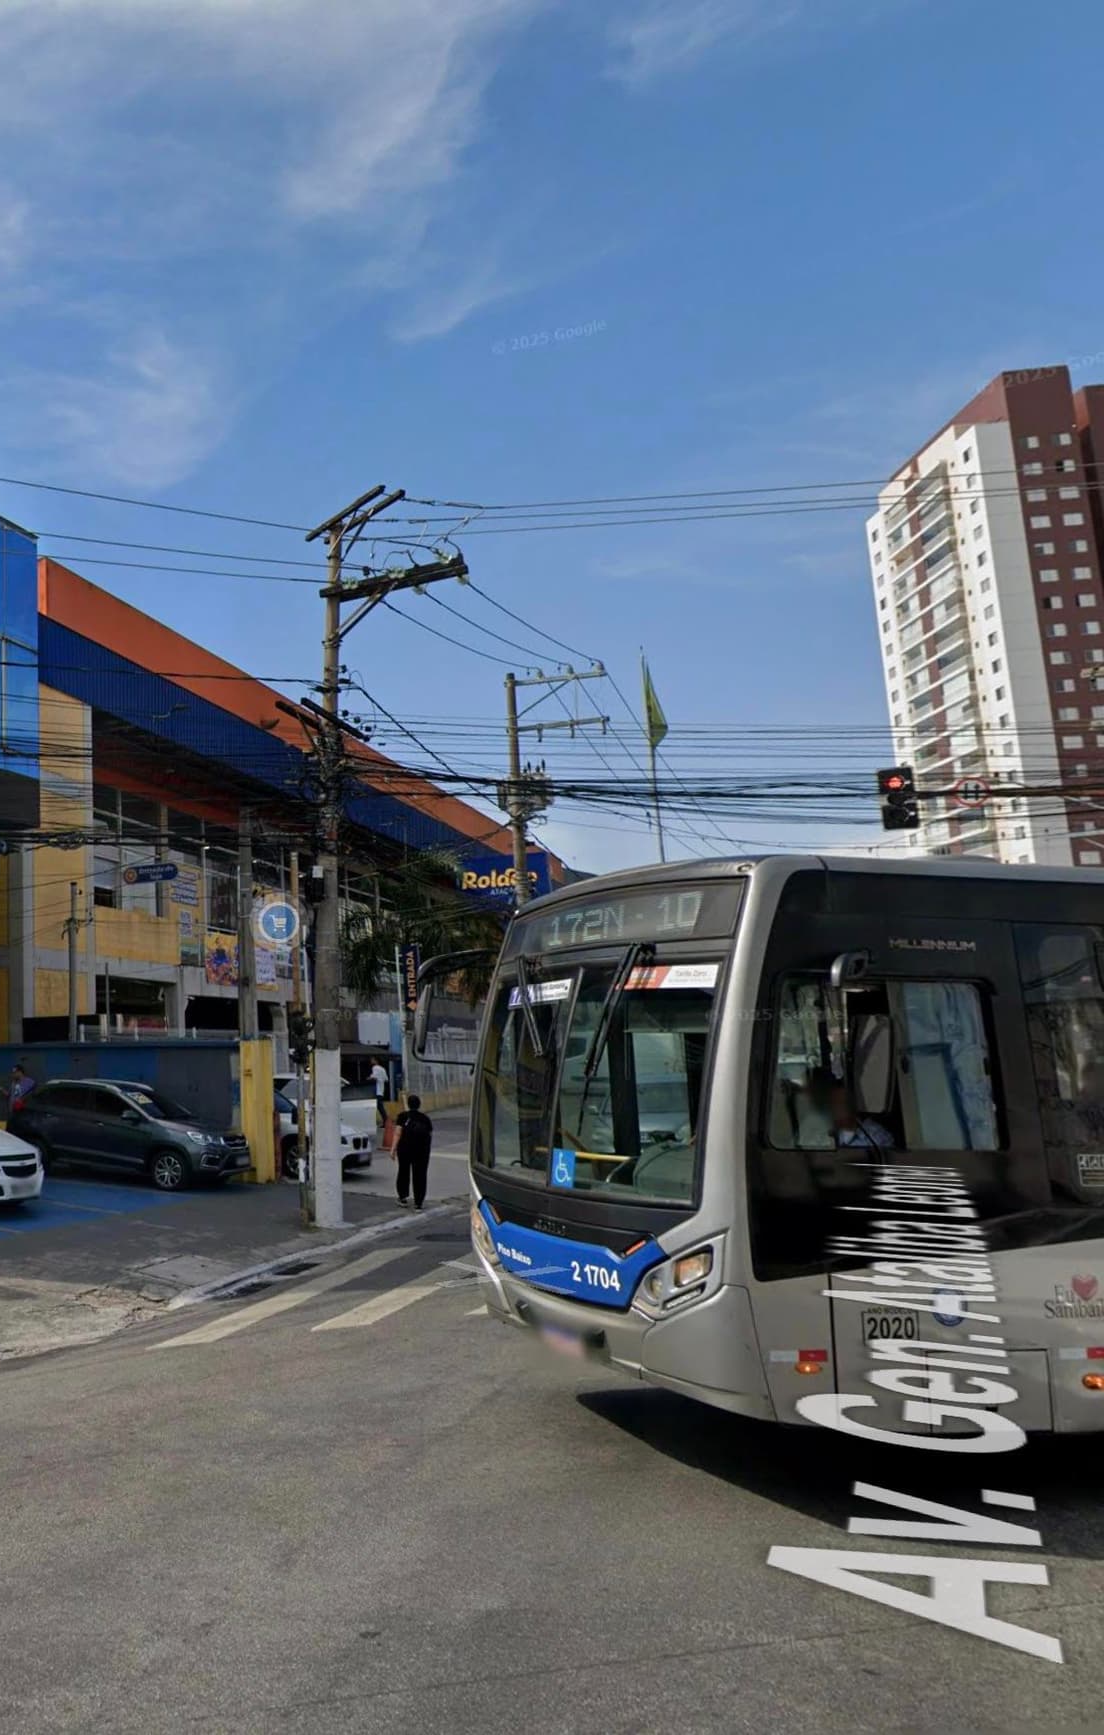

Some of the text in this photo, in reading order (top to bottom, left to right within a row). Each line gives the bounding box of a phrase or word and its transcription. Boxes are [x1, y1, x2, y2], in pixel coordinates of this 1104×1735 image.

[462, 868, 538, 890] Roldo
[548, 904, 625, 946] 172N
[656, 891, 704, 932] 10
[889, 938, 976, 951] MILLENNIUM
[406, 951, 417, 998] ENTRADA
[570, 1260, 621, 1292] 2 1704
[1054, 1283, 1075, 1304] Eu
[867, 1316, 915, 1340] 2020
